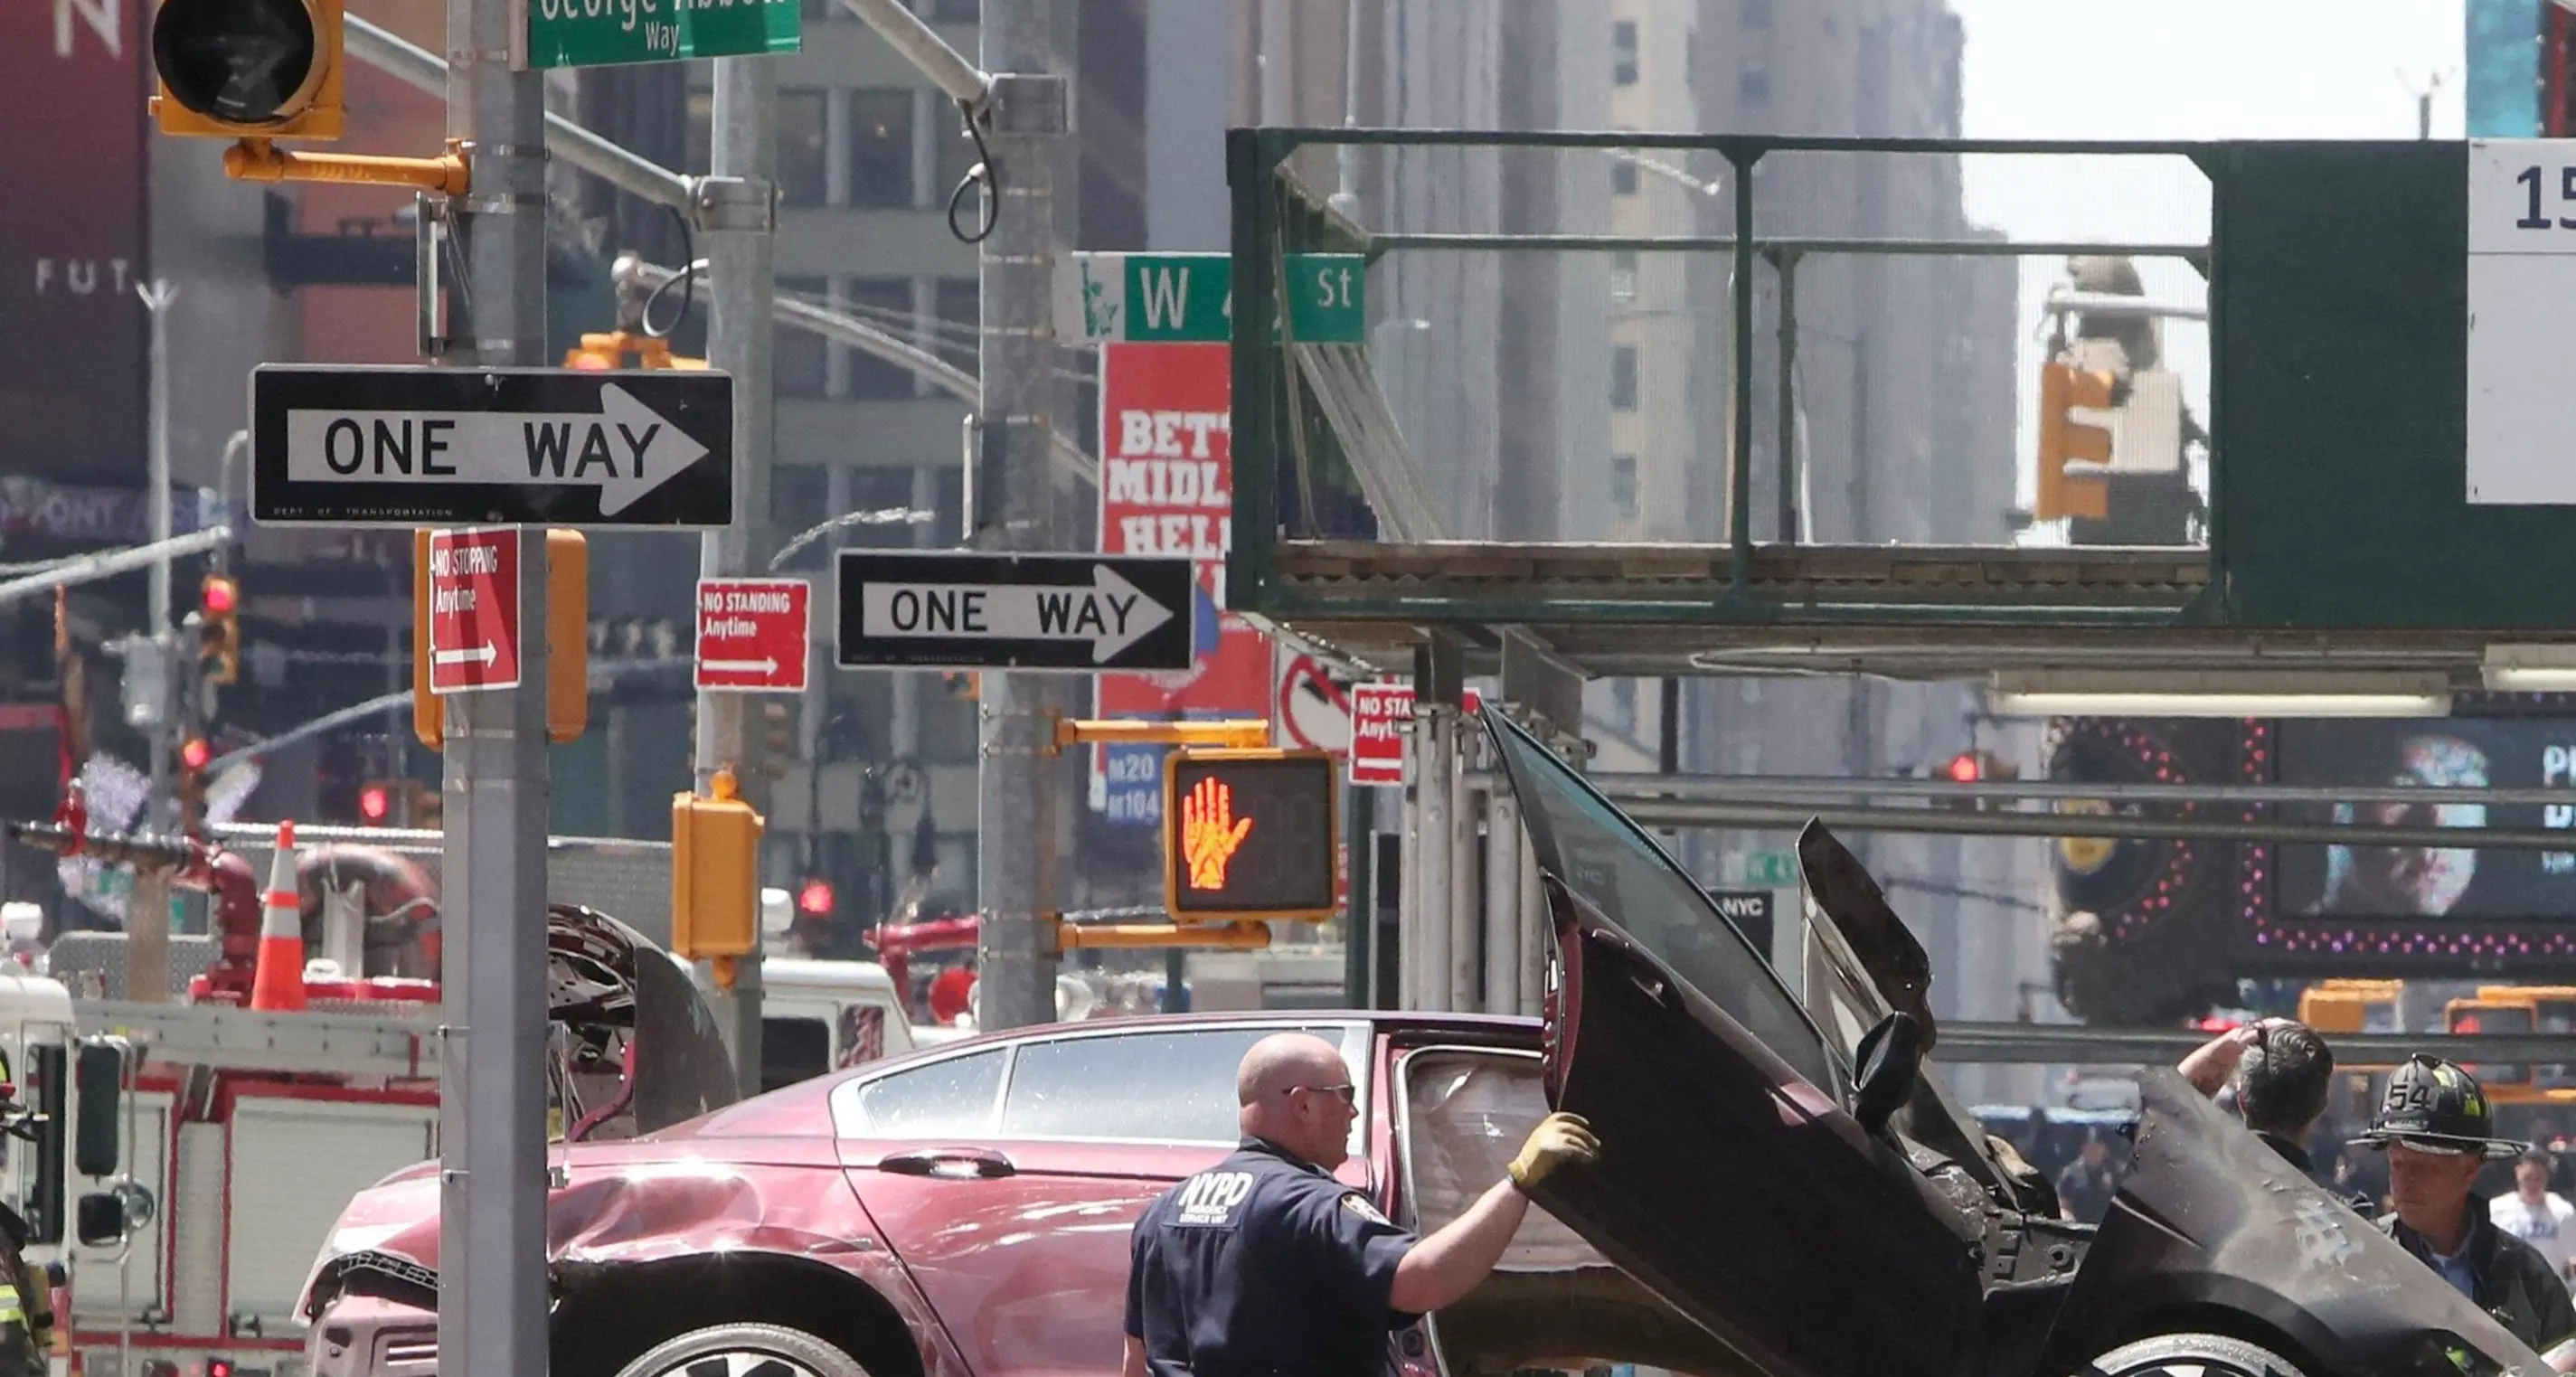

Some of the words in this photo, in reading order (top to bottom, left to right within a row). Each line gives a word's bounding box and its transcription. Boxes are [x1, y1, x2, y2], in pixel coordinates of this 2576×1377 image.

[646, 22, 679, 57] Way
[1139, 268, 1190, 330] W
[1317, 267, 1351, 308] St
[325, 418, 456, 475] ONE
[524, 421, 662, 479] WAY
[435, 548, 450, 577] NO
[452, 544, 498, 577] STOPPING
[435, 584, 477, 620] Anytime
[704, 591, 724, 614] NO
[726, 591, 791, 615] STANDING
[891, 589, 988, 632] ONE
[1036, 592, 1138, 636] WAY
[704, 616, 758, 642] Anytime
[1359, 696, 1382, 716] NO
[1383, 696, 1417, 717] STA
[1722, 896, 1764, 917] NYC
[2389, 1083, 2431, 1110] 54
[1177, 1172, 1253, 1207] NYPD
